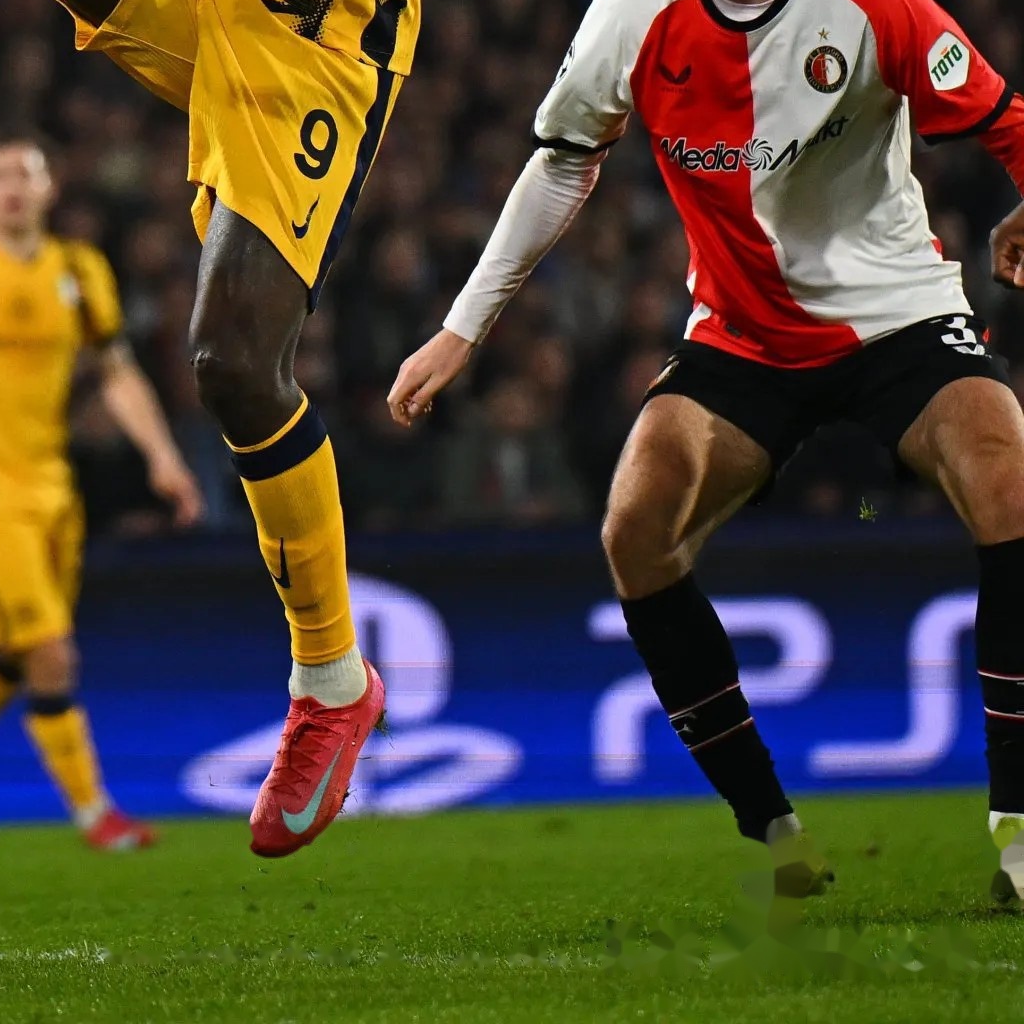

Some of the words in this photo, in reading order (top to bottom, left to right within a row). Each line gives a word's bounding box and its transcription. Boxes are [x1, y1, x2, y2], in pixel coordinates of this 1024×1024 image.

[931, 44, 963, 82] TOTO
[294, 109, 339, 180] 9
[660, 137, 741, 172] Media
